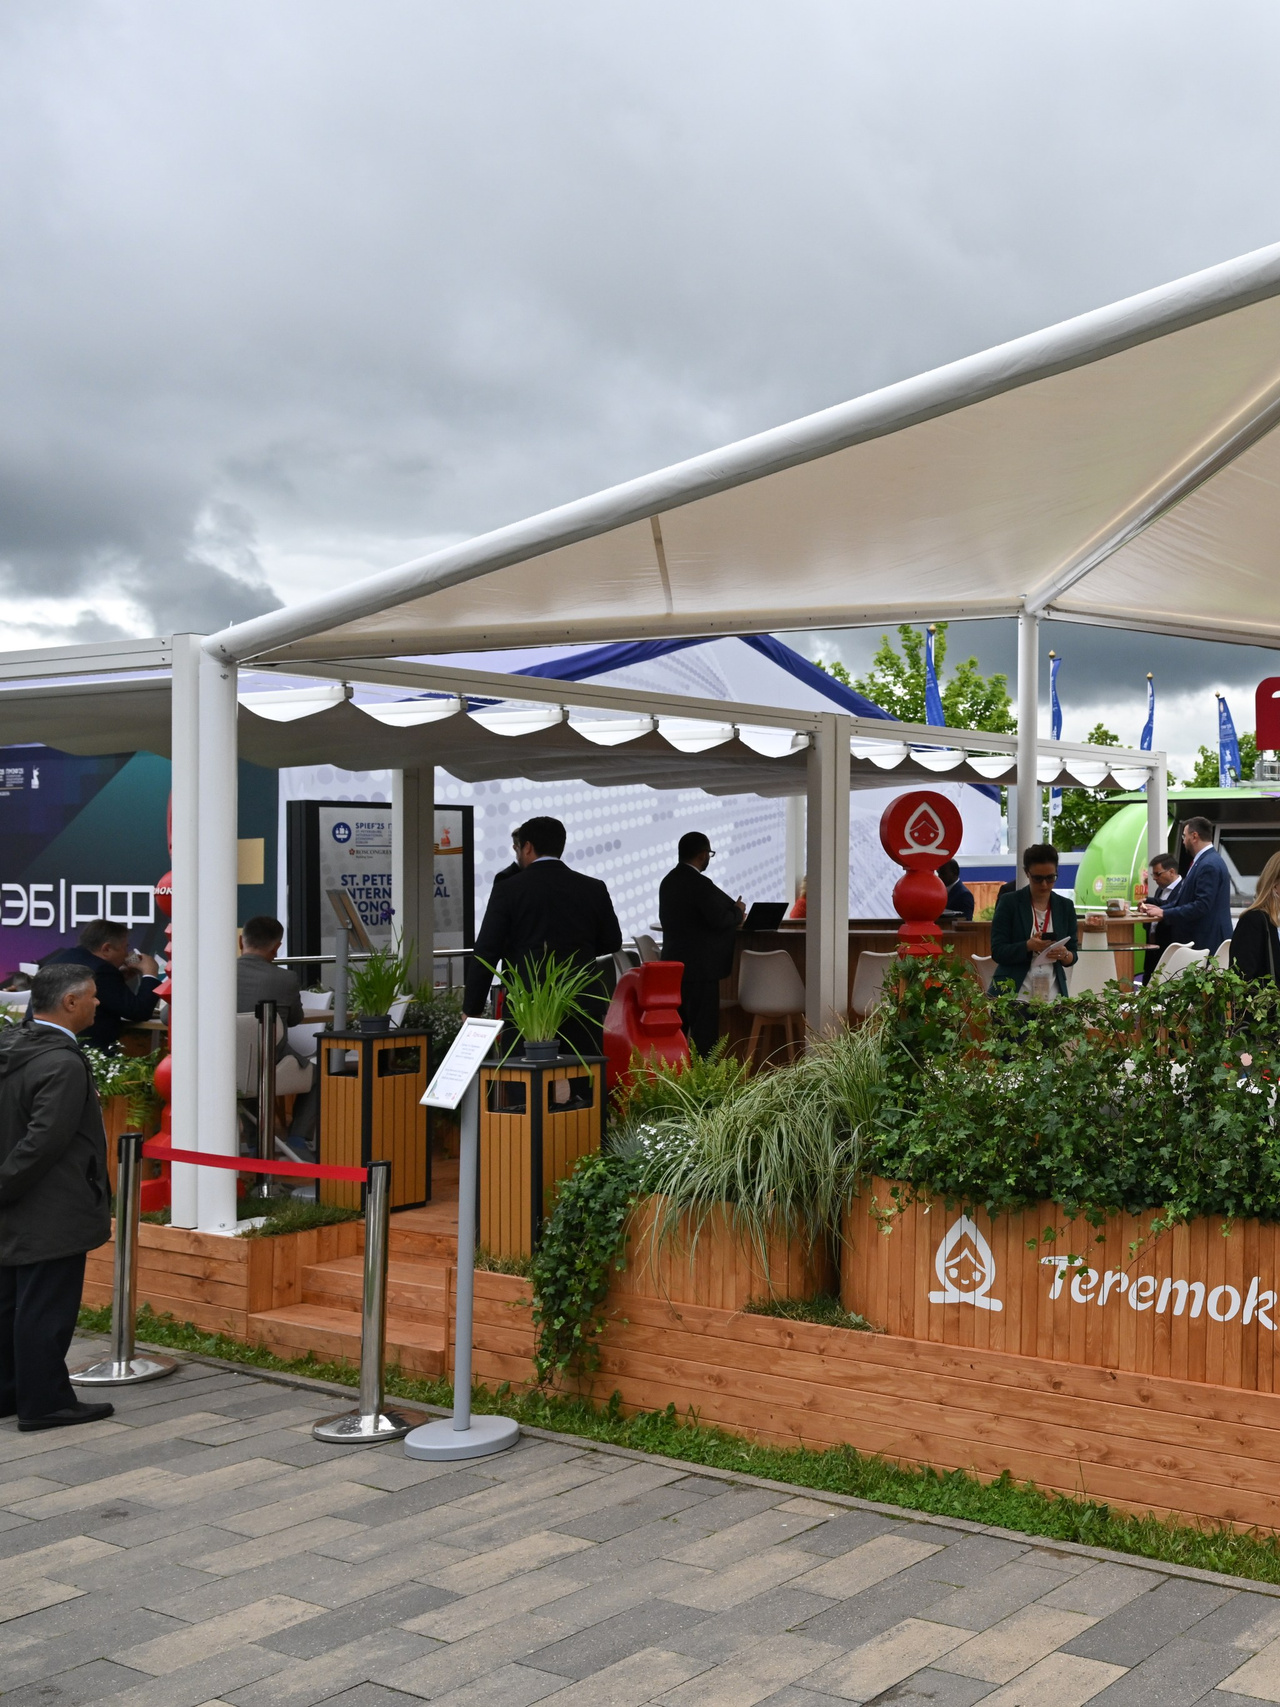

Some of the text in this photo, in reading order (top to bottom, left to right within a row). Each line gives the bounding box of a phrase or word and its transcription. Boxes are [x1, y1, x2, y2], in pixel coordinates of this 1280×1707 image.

[355, 822, 385, 830] SPIEF'25
[341, 874, 359, 886] ST.
[1039, 1255, 1278, 1331] Teremok
